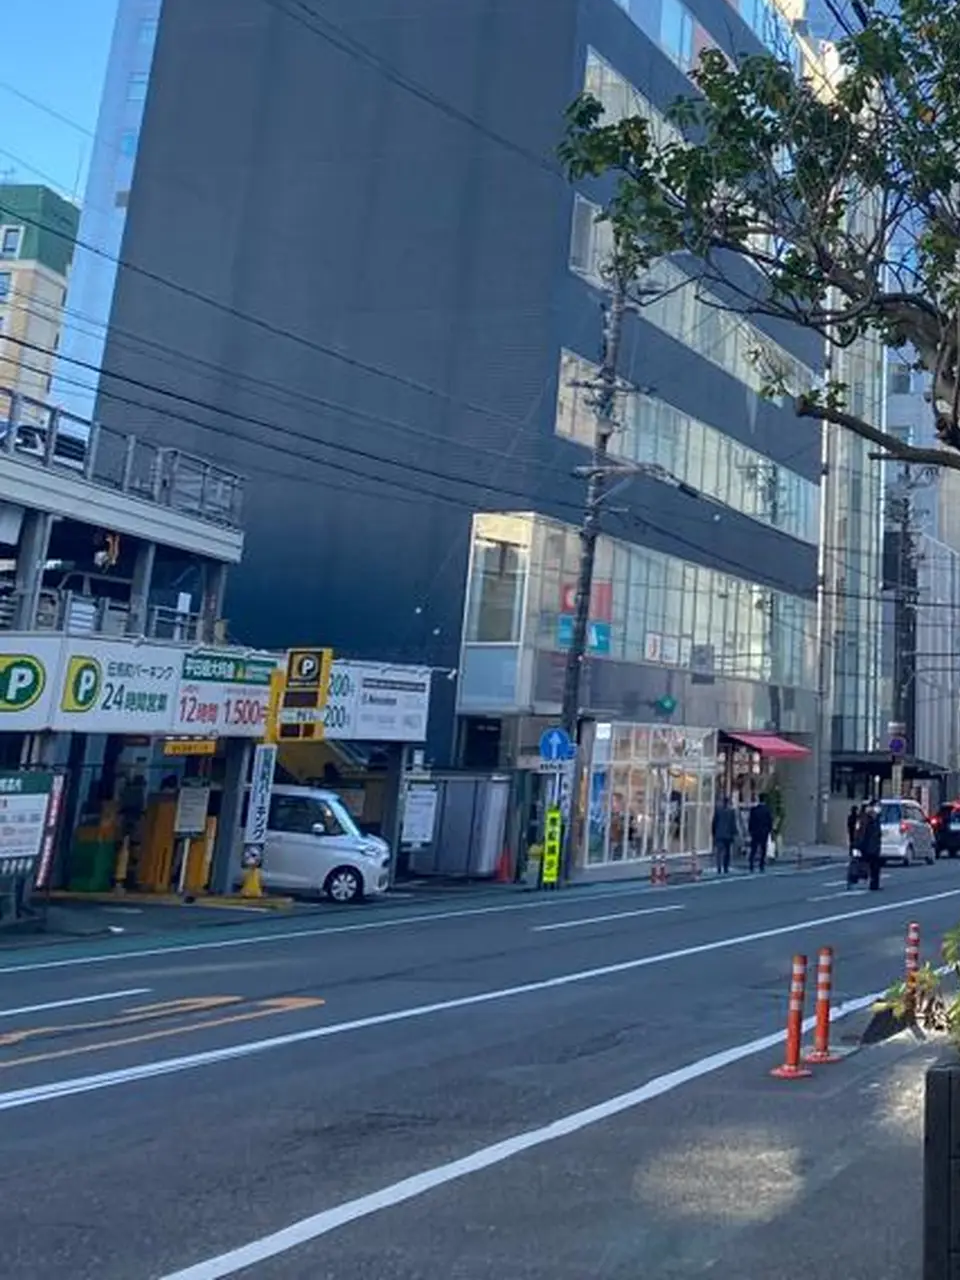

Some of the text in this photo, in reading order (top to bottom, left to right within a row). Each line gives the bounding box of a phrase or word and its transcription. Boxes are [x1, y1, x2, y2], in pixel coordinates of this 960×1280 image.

[6, 667, 35, 701] P
[301, 659, 315, 675] P
[77, 669, 96, 703] P
